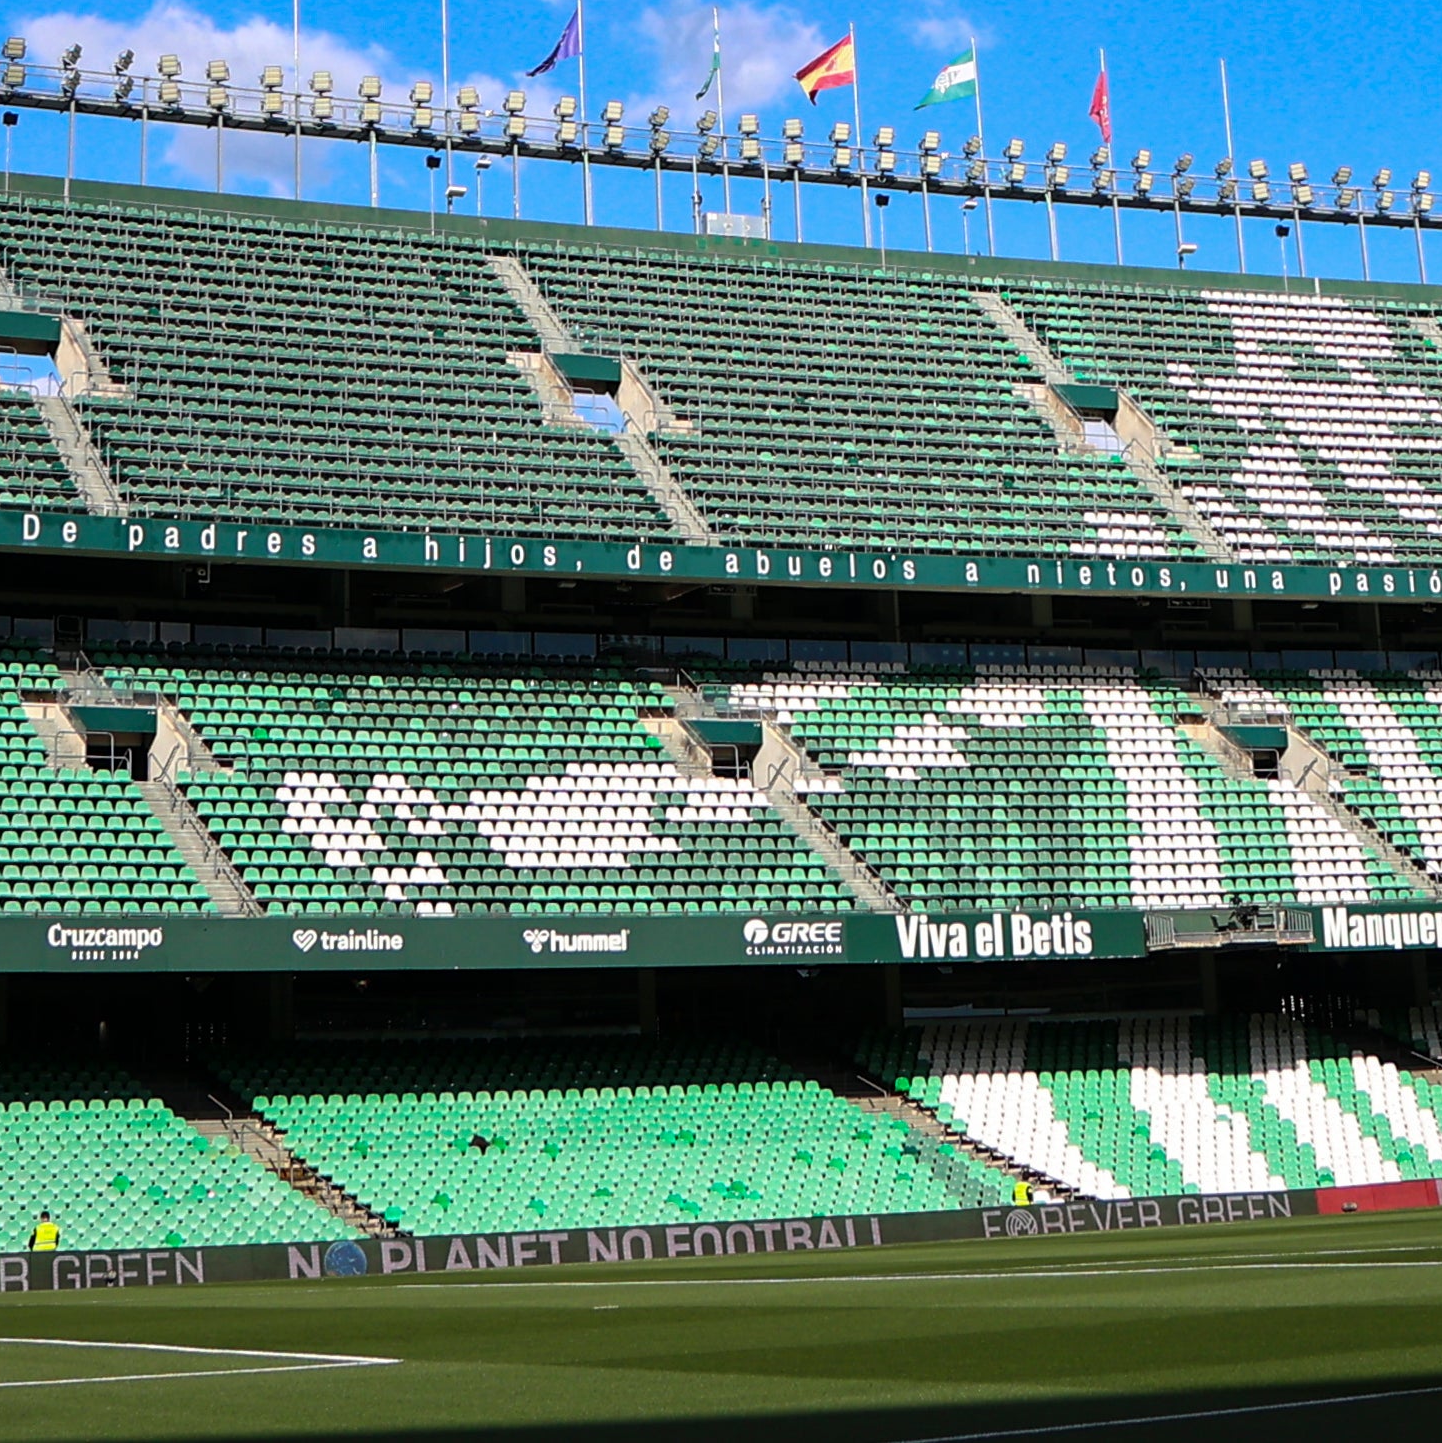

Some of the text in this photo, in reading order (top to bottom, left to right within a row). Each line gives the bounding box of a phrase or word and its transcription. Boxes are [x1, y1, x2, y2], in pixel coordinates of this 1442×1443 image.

[23, 514, 78, 542] De
[129, 523, 315, 555] padres
[363, 537, 377, 558] a
[627, 545, 673, 571] de
[725, 550, 916, 579] abuelos
[965, 561, 978, 582] a
[1216, 570, 1284, 589] una
[47, 923, 162, 950] Cruzcampo
[321, 930, 403, 951] trainline
[551, 929, 627, 952] hummel
[772, 922, 842, 942] GREE
[895, 913, 1092, 958] Viva el Betis
